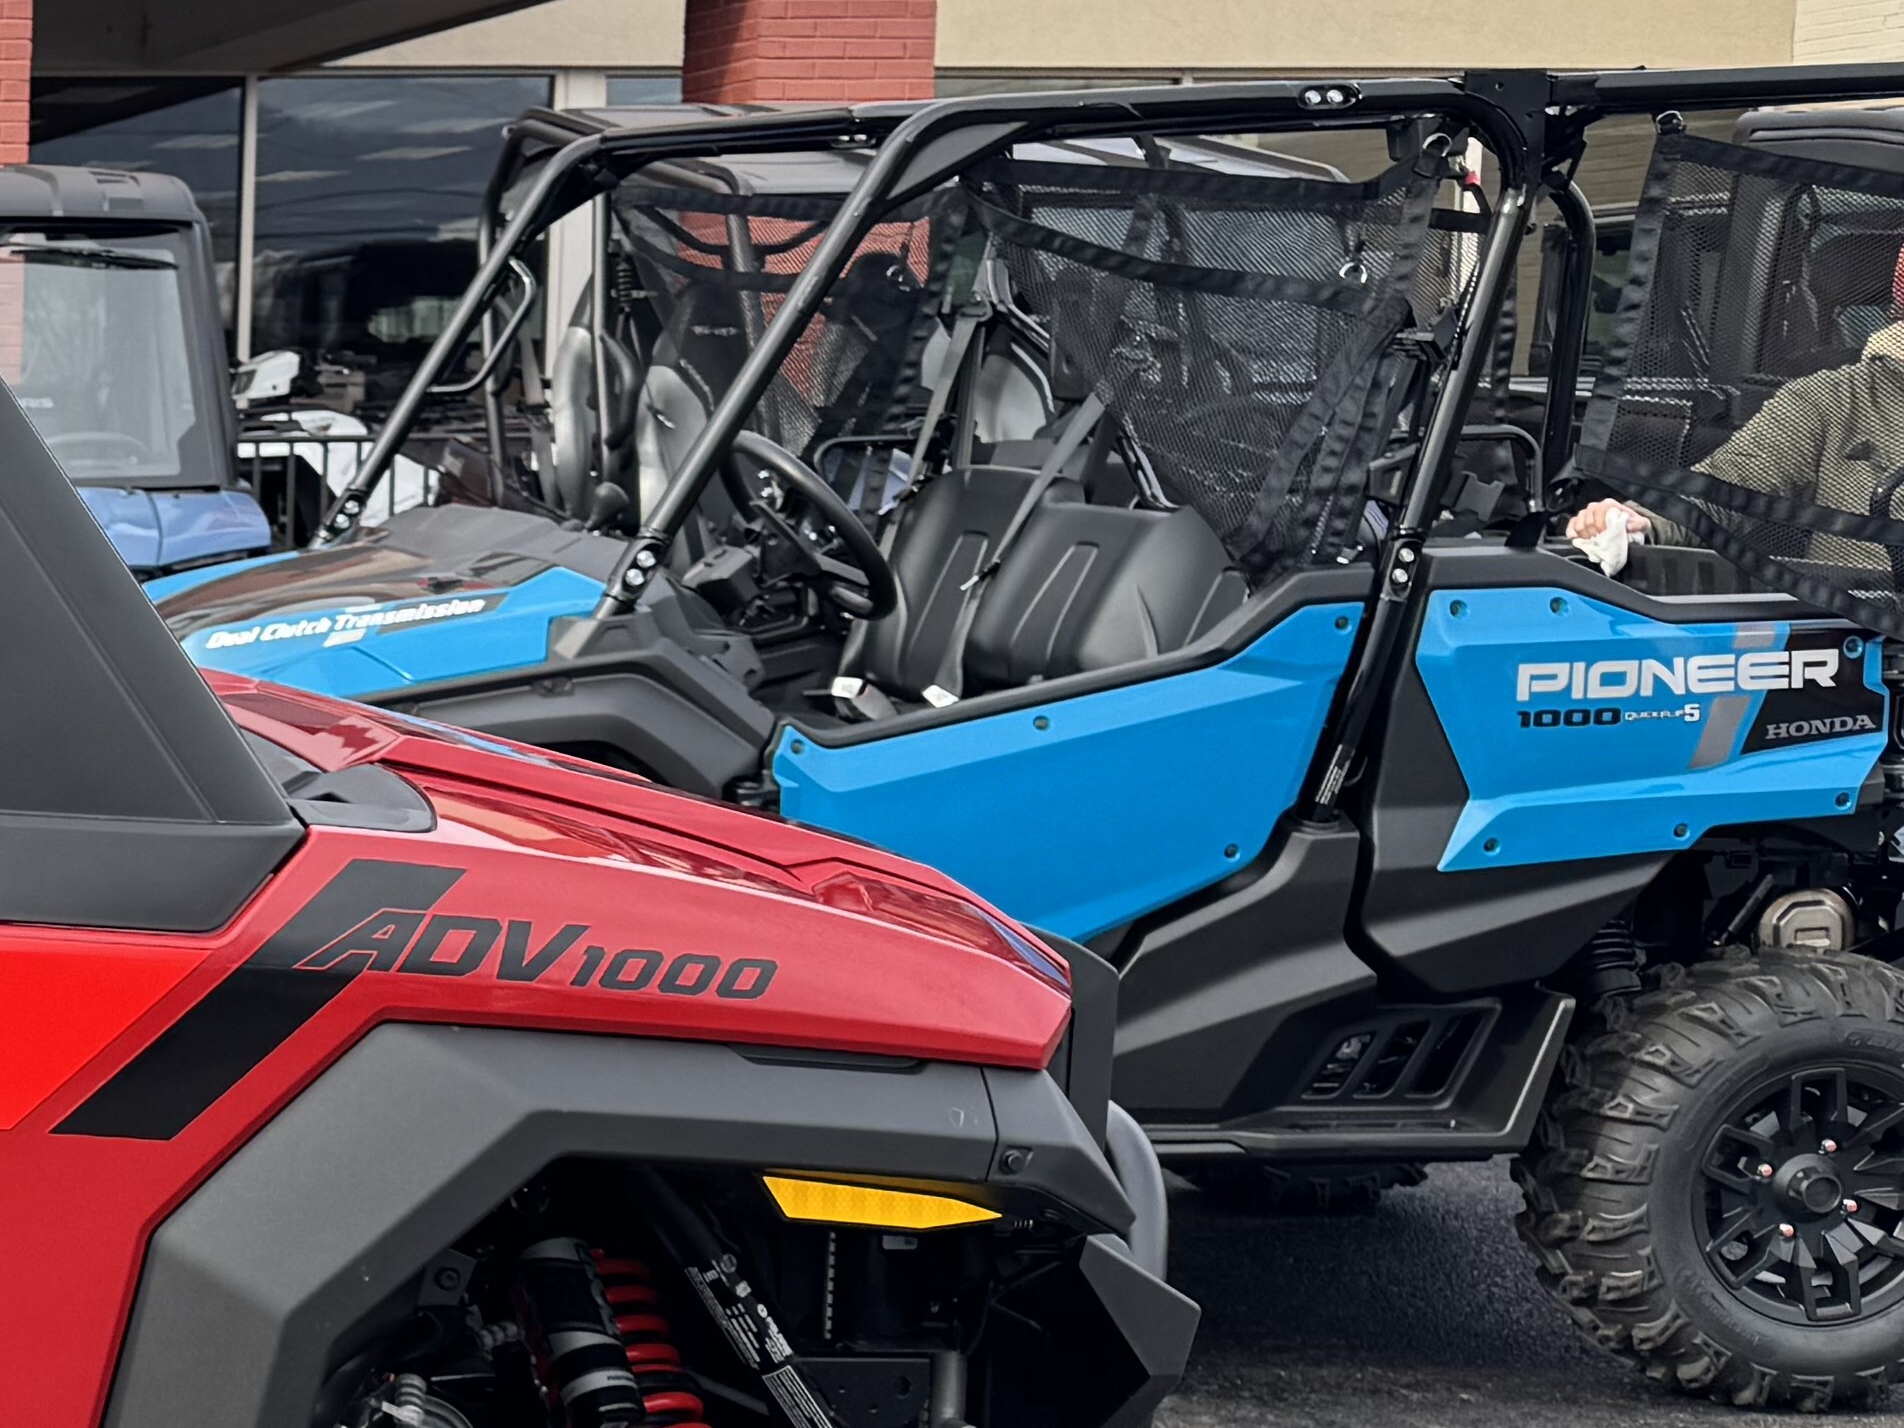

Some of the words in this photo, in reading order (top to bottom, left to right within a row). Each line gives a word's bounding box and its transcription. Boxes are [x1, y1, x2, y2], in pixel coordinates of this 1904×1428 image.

[204, 626, 261, 650] Dual
[260, 616, 333, 644] Clutch
[333, 598, 487, 632] Transmission
[1516, 648, 1840, 702] PIONEER
[1517, 707, 1622, 729] 1000
[1765, 714, 1877, 740] HONDA
